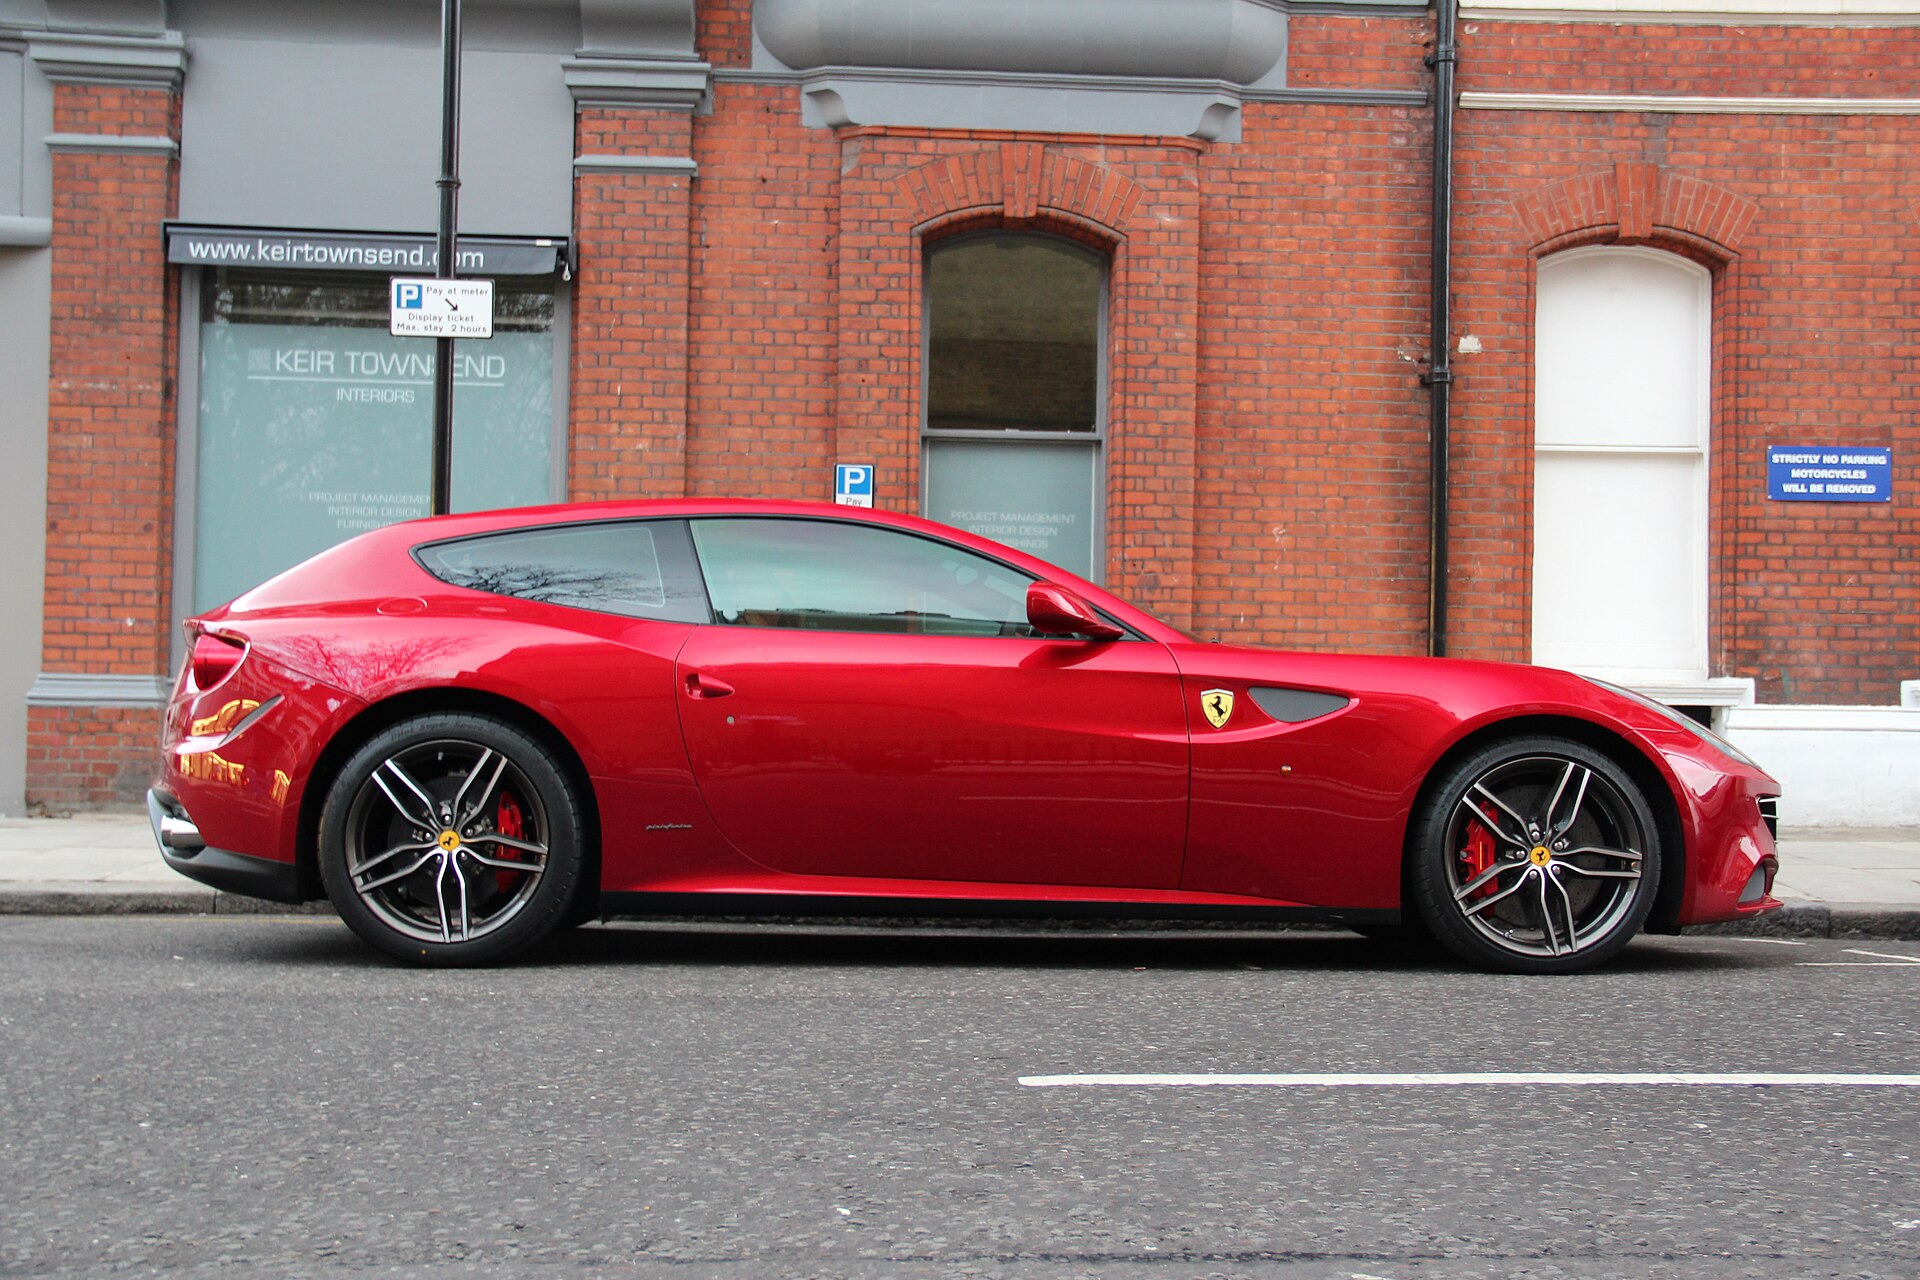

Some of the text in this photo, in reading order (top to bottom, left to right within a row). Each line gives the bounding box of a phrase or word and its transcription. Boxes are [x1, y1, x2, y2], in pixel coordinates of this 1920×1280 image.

[189, 239, 484, 268] www.keirtownsend.m
[401, 285, 419, 308] P
[426, 286, 443, 296] Pay
[461, 288, 489, 296] meter
[408, 313, 474, 322] Display ticket
[396, 323, 420, 331] Max.
[424, 324, 444, 333] stay
[460, 324, 487, 333] hours
[276, 349, 506, 378] KEIR TOWNEND
[337, 387, 415, 403] INTERIORS
[1771, 454, 1888, 465] STRICTLY NO PARKING
[1791, 469, 1868, 479] MOTORCYCLES
[844, 467, 866, 495] P
[1782, 484, 1876, 494] WILL BE REMOVED
[308, 491, 358, 503] PROJECT
[328, 506, 422, 518] INTERIOR DESIGN
[950, 511, 1077, 524] PROJECT MANAGEMENT
[968, 524, 1058, 537] INTERIOR DESIGN
